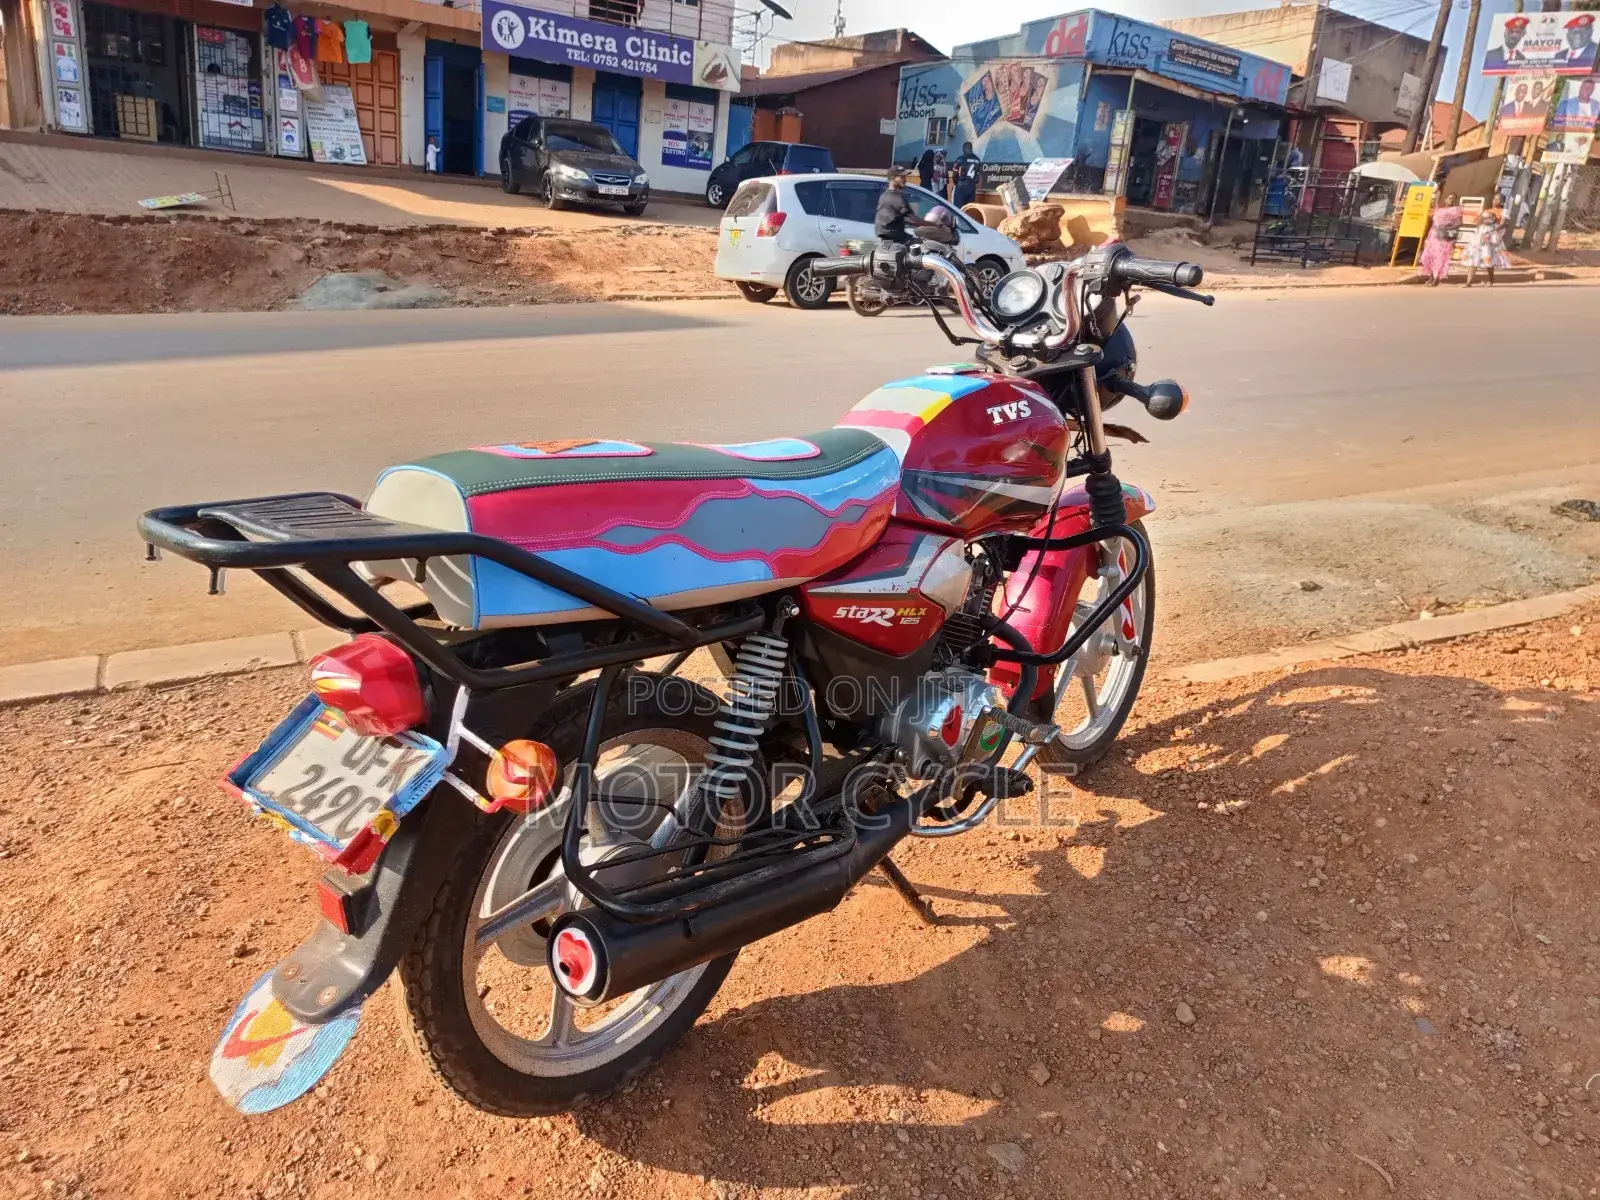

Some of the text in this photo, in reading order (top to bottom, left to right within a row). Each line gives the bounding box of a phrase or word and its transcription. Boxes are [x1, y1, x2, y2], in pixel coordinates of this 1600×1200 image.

[528, 16, 691, 66] Kimera Clinic
[1107, 18, 1151, 60] kiss
[1523, 39, 1562, 47] MAYOR
[566, 48, 658, 75] TEL: 0752 421754
[900, 77, 938, 109] kiss
[898, 109, 936, 120] CONDOMS
[662, 148, 686, 156] TESTING
[967, 164, 976, 179] 4
[982, 163, 1000, 173] Quality
[987, 174, 1013, 183] pleasure
[986, 400, 1032, 424] TVS
[896, 607, 928, 616] HLX
[899, 616, 921, 625] 125
[341, 736, 430, 793] UFK
[278, 764, 381, 840] 249C
